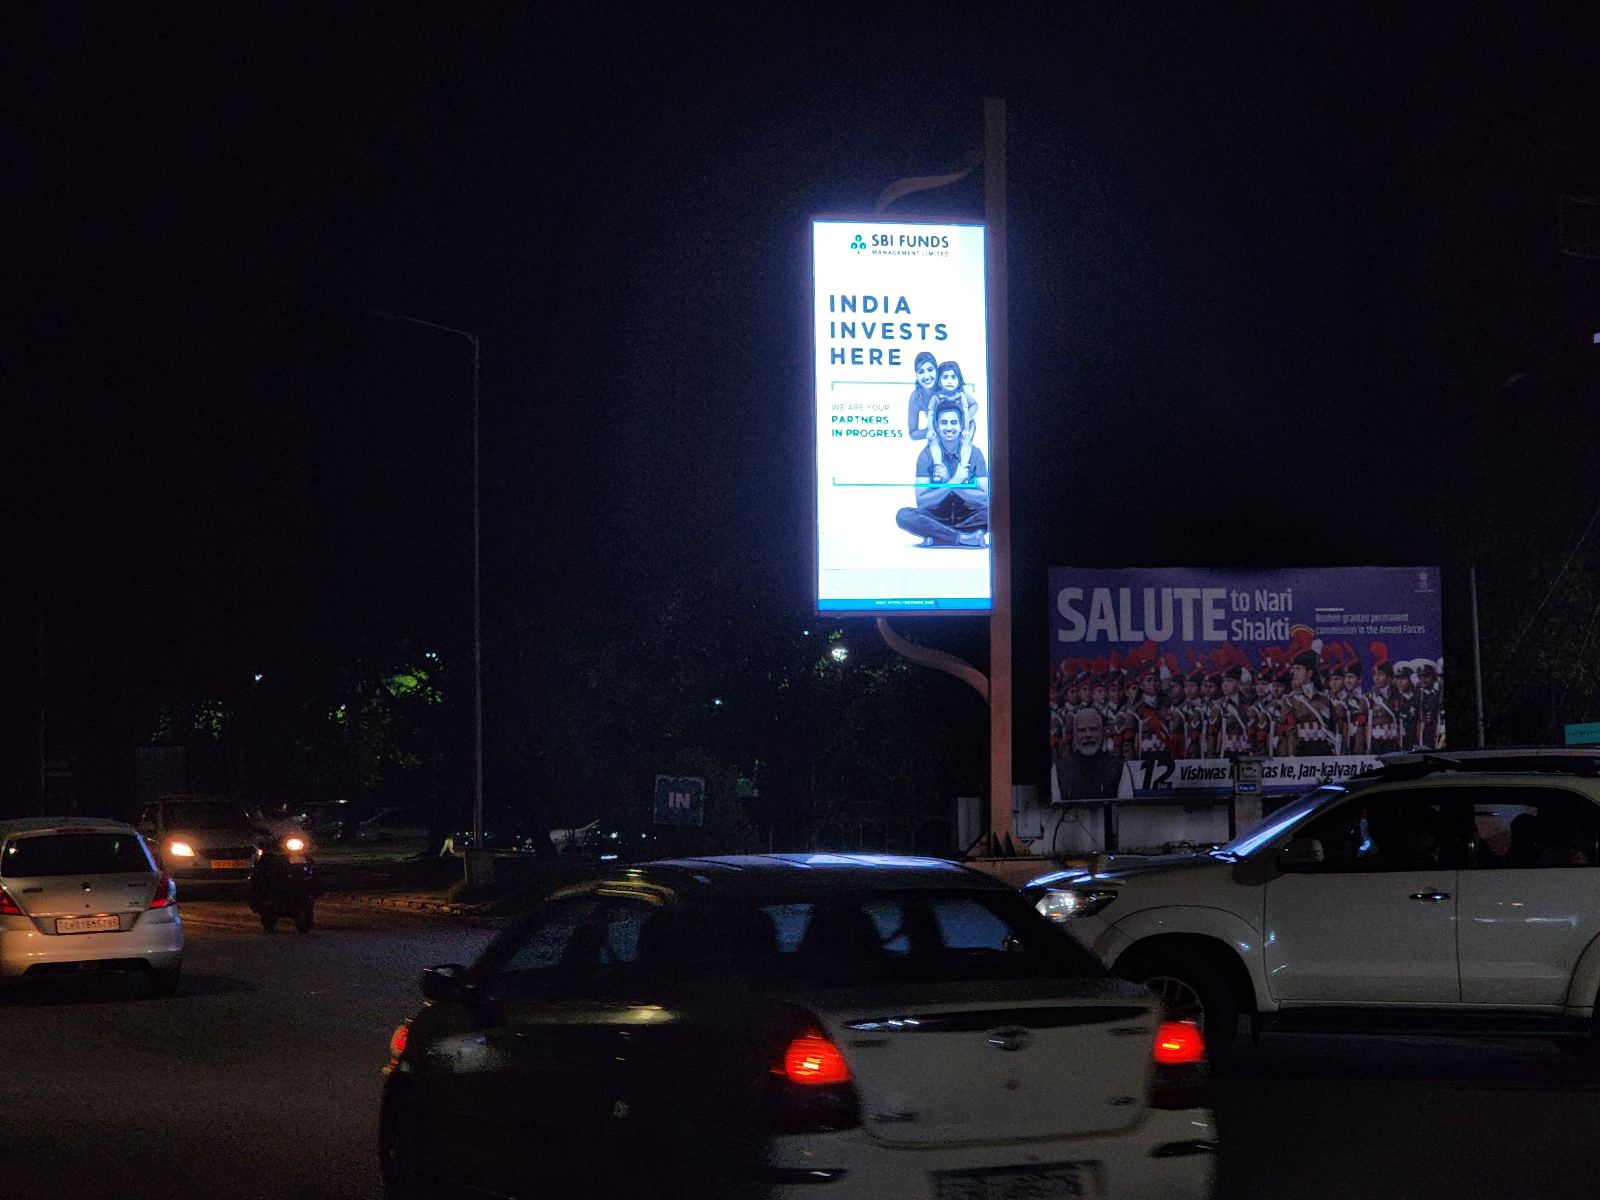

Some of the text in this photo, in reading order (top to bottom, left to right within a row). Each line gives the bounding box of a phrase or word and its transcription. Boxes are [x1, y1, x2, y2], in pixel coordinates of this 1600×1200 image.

[871, 233, 949, 249] SBI FUNDS
[829, 294, 912, 315] INDIA
[830, 321, 948, 341] INVESTS
[830, 347, 902, 366] HERE
[831, 403, 890, 412] WE ARE YOUR
[831, 415, 889, 424] PARTNERS
[831, 429, 903, 438] IN PROGRESS
[1230, 588, 1293, 612] to Nari
[1056, 587, 1228, 643] SALUTE
[1231, 616, 1290, 641] Shakti
[1140, 759, 1176, 791] 12
[1180, 765, 1227, 780] Vishwas
[668, 791, 691, 810] IN
